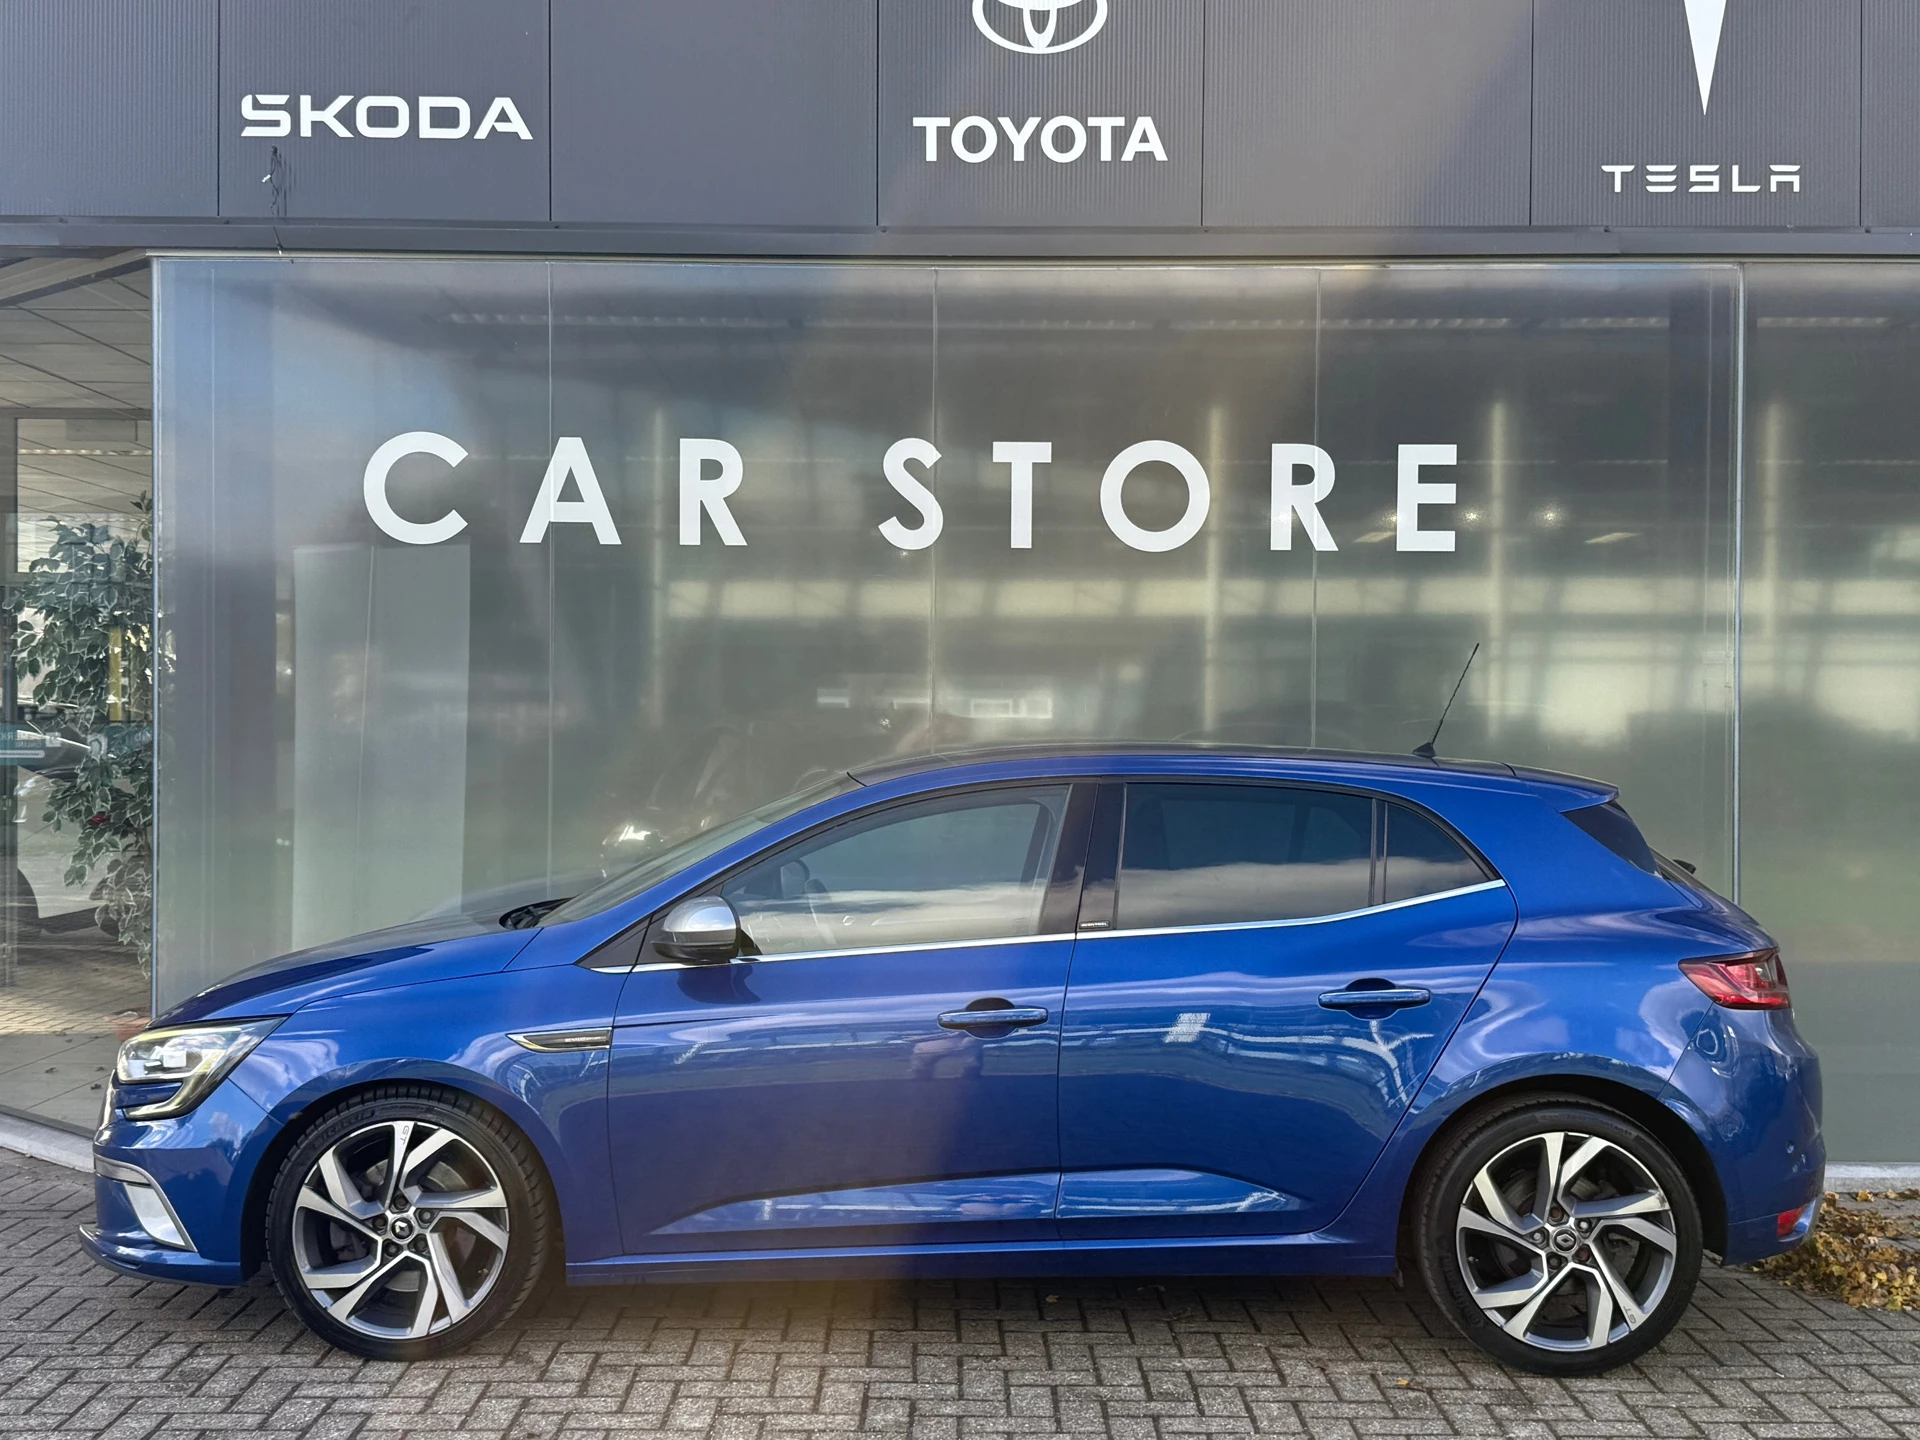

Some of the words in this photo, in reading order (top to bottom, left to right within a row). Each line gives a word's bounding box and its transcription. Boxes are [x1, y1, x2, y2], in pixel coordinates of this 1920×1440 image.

[240, 94, 534, 140] SKODA
[912, 115, 1168, 164] TOYOTA
[1600, 164, 1801, 193] TESLA
[363, 431, 748, 546] CAR
[878, 438, 1458, 553] STORE
[399, 1125, 410, 1146] GT
[1622, 1305, 1637, 1324] GT
